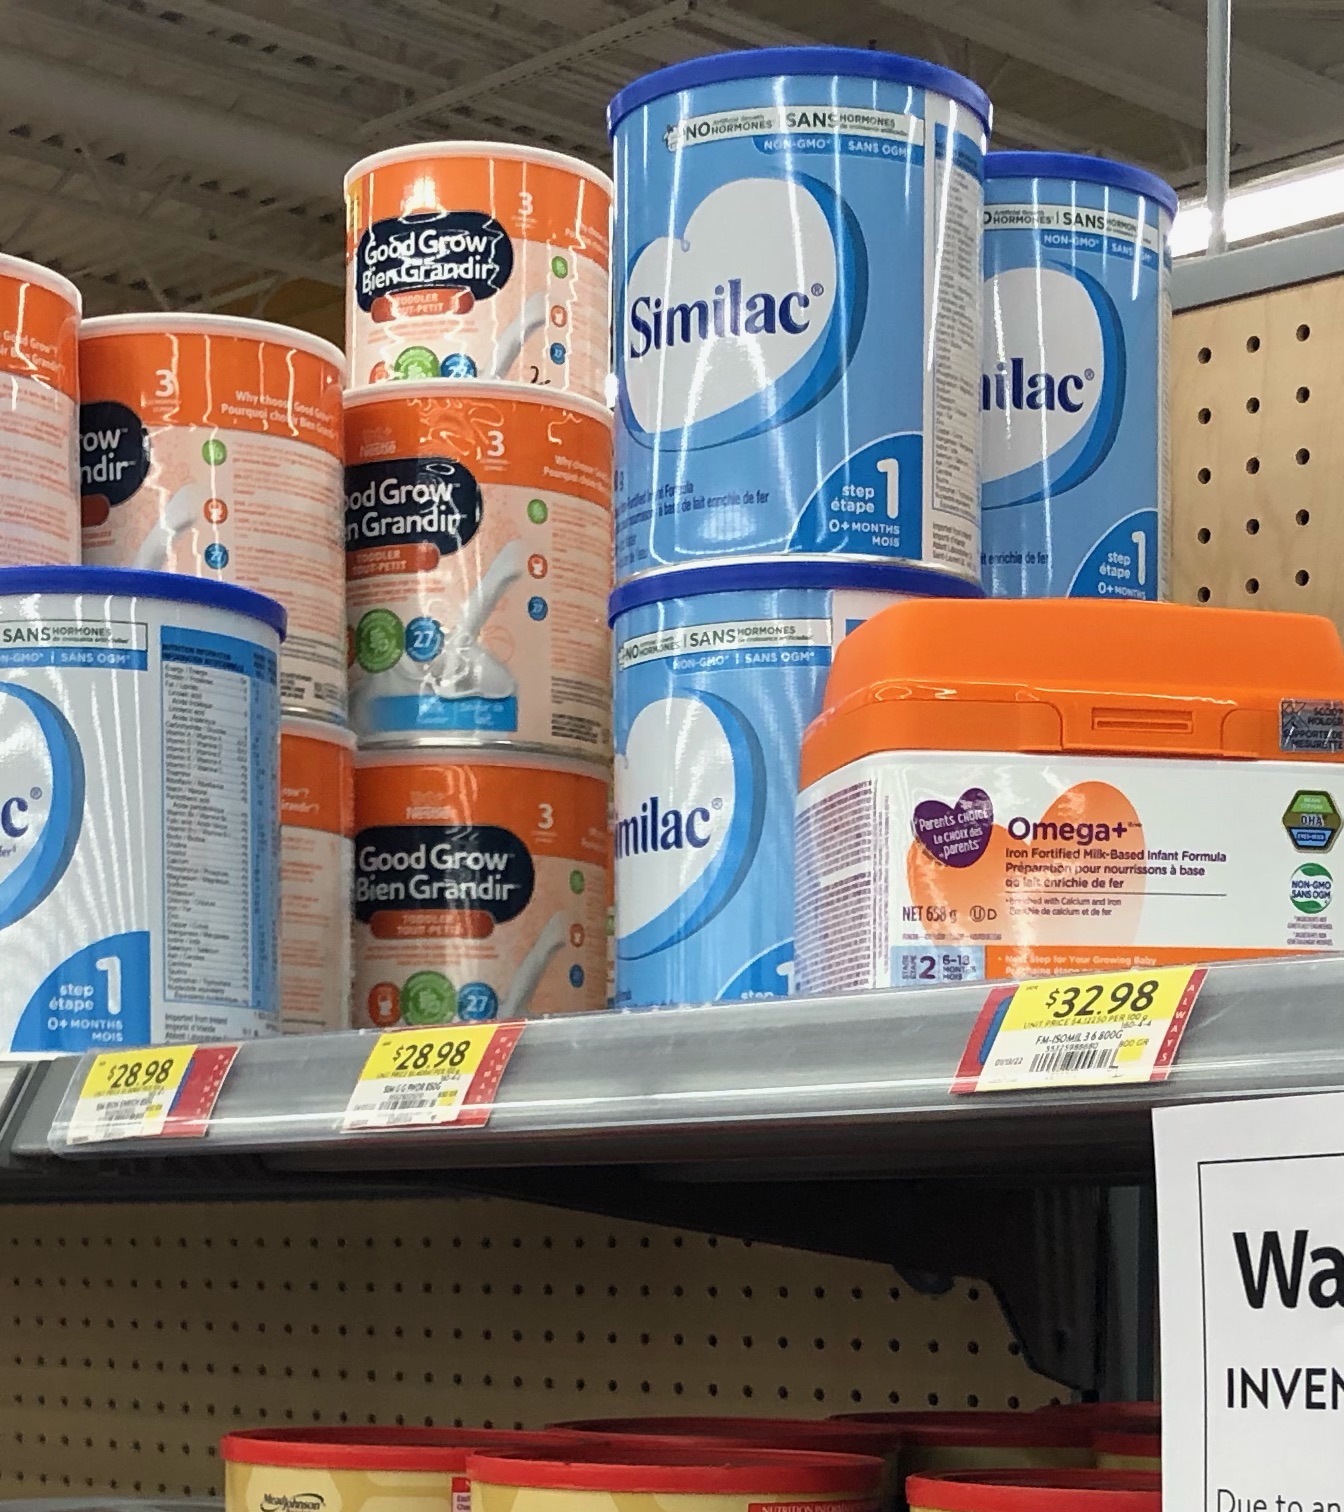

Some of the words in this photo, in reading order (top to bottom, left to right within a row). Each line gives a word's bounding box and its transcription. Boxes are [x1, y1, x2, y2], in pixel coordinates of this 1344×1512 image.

[686, 122, 710, 140] NO
[365, 231, 416, 265] Good
[419, 229, 487, 253] Grow
[842, 482, 874, 500] step
[876, 458, 898, 518] 1
[831, 498, 874, 515] étape
[539, 804, 554, 829] 3
[360, 843, 425, 872] Good
[431, 843, 508, 872] Grow
[1006, 849, 1028, 859] Iron
[1031, 849, 1080, 859] Fortified
[1148, 850, 1179, 861] Infant
[1181, 851, 1227, 863] Formula
[1075, 865, 1100, 875] pour
[1104, 865, 1166, 875] nourrissons
[1180, 865, 1205, 875] base
[356, 873, 404, 902] Bien
[410, 873, 516, 902] Grandir
[1046, 980, 1159, 1018] $32.98
[392, 1040, 471, 1070] $28.98
[108, 1059, 173, 1085] $28.98
